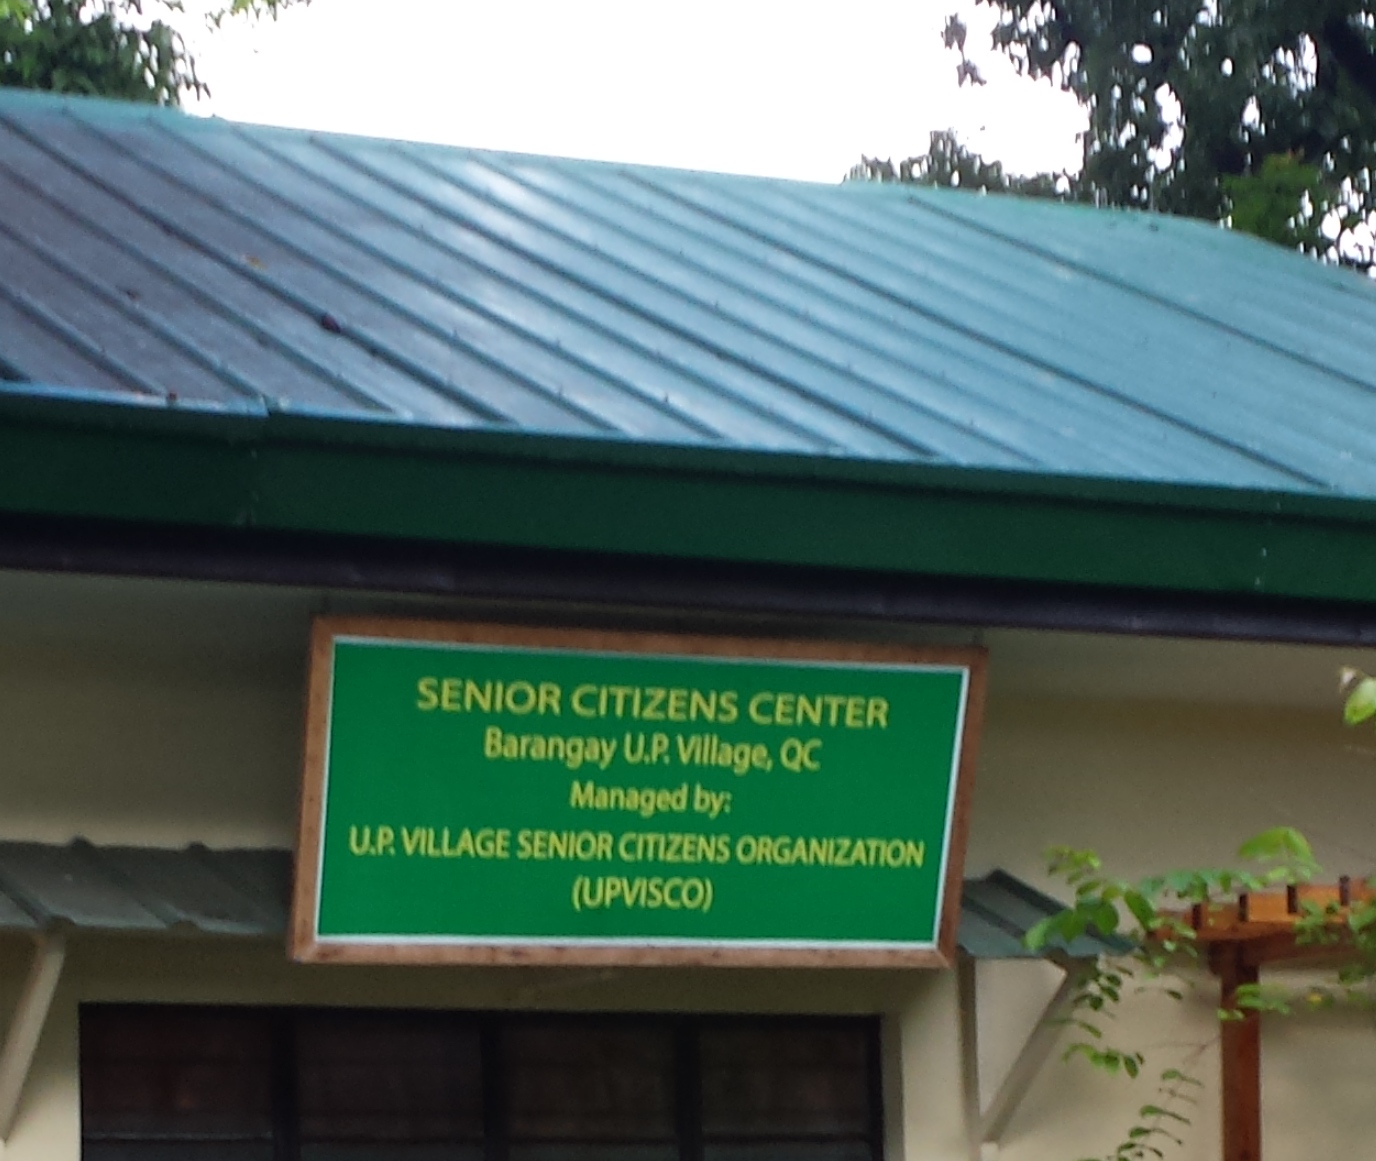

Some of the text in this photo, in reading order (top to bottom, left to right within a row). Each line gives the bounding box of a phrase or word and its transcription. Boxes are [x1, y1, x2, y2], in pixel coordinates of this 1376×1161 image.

[418, 678, 888, 728] SENIOR CITIZENS CENTER
[484, 726, 821, 774] Barangay U.P. Village, QC
[570, 781, 731, 818] Managed by:
[349, 826, 925, 867] U.P. VILLAGE SENIOR CITIZENS ORGANIZATION
[572, 876, 713, 911] (UPVISCO)
